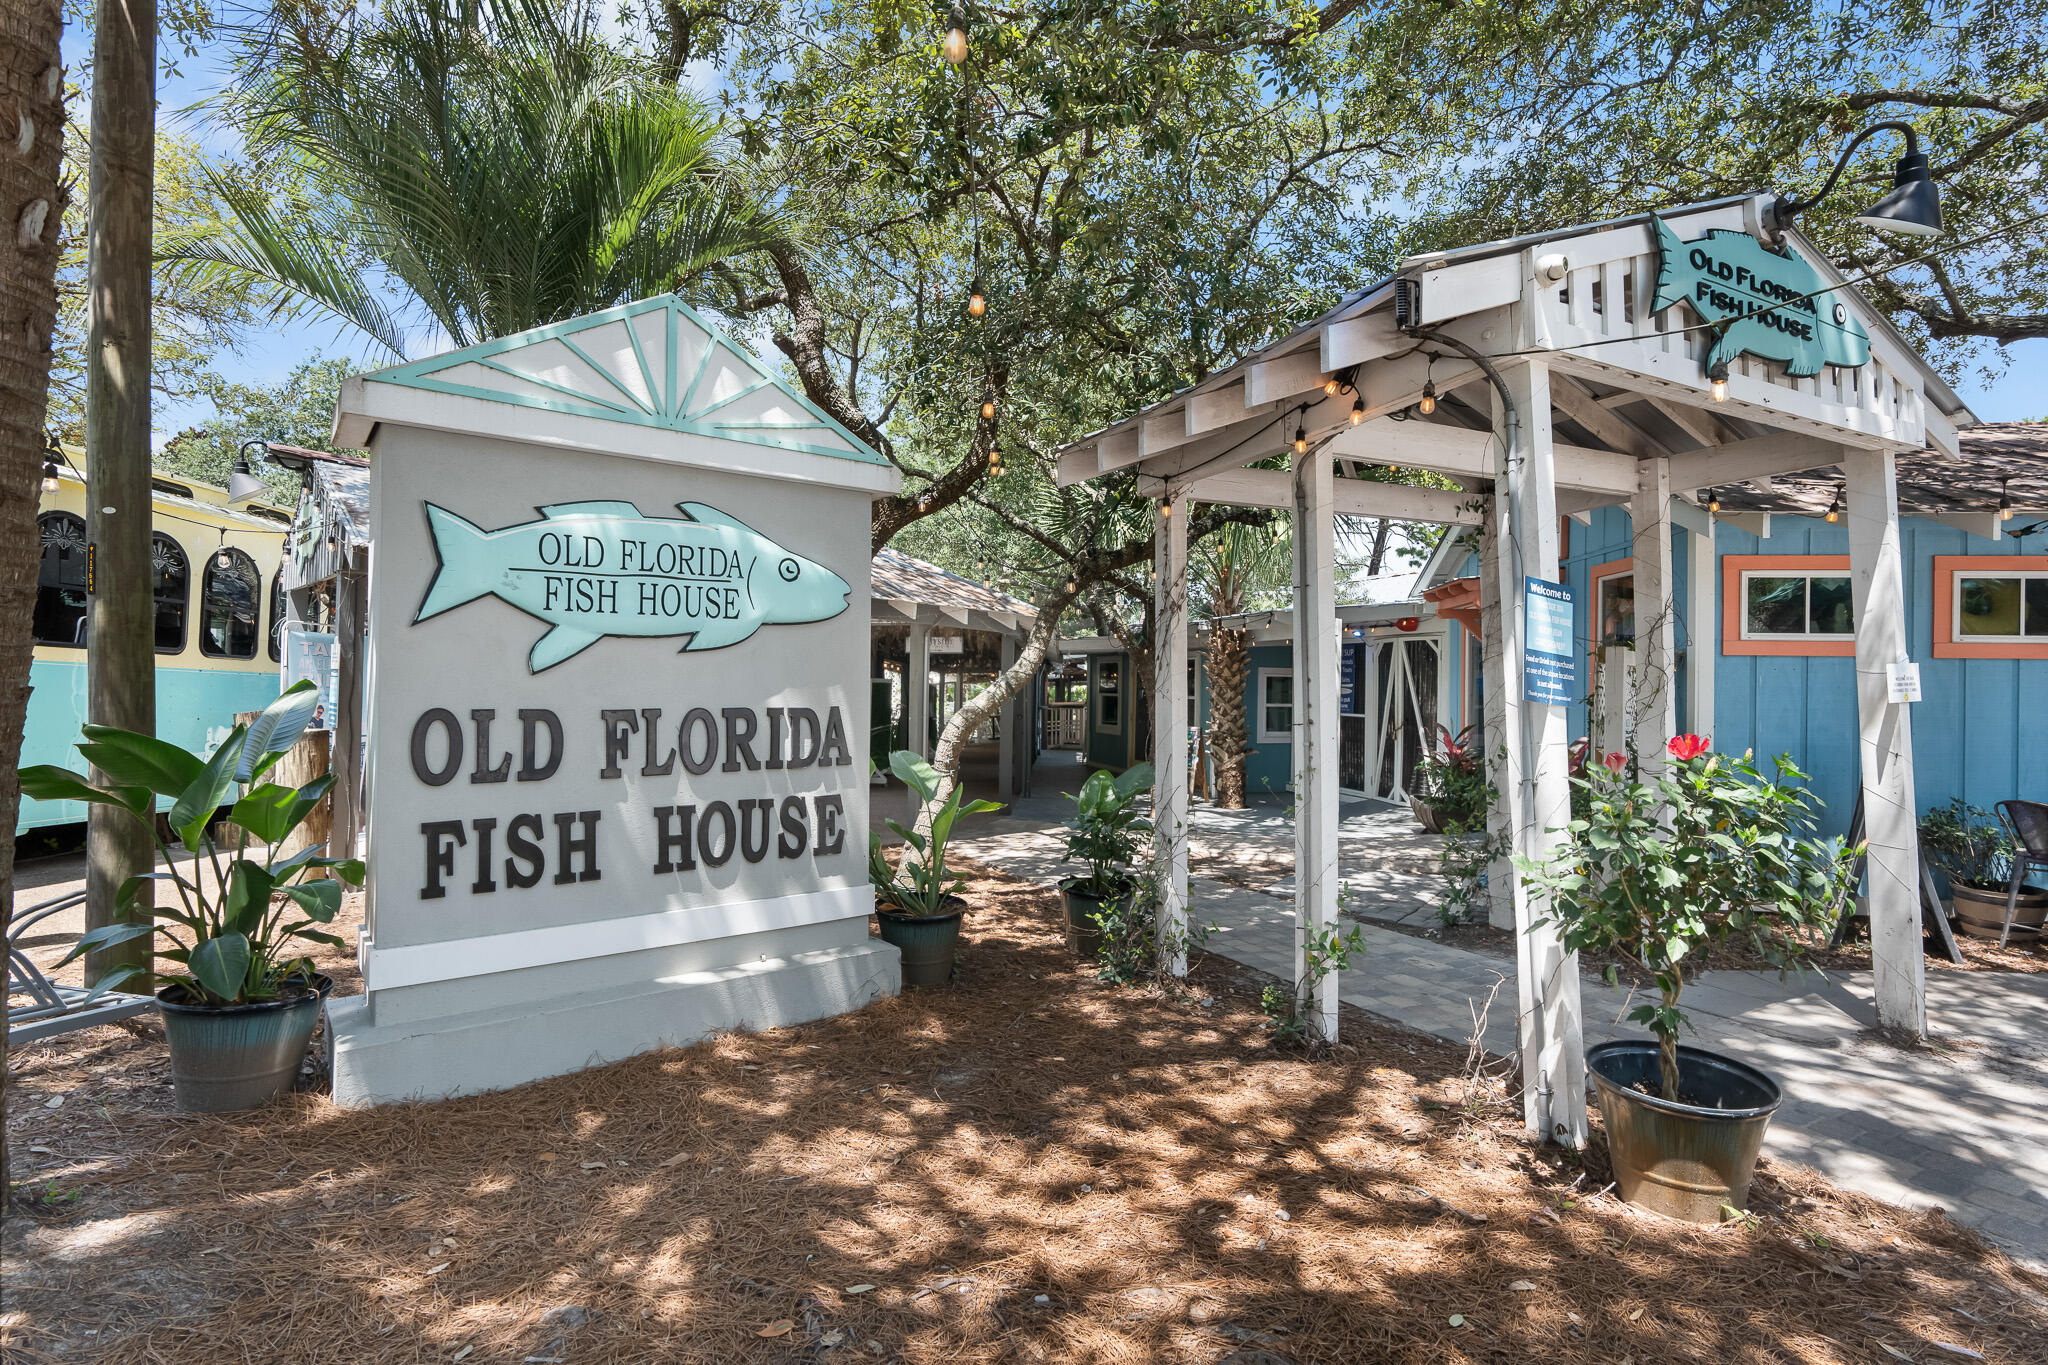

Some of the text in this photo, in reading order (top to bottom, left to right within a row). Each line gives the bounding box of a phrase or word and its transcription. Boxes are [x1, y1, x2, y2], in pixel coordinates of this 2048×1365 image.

[1689, 248, 1817, 315] OLD FLORIDA
[1696, 281, 1814, 342] FISH HOUSE
[538, 532, 744, 578] OLD FLORIDA
[543, 577, 741, 620] FISH HOUSE
[1530, 582, 1571, 601] Welcome to
[410, 705, 853, 787] OLD FLORIDA
[420, 794, 845, 900] FISH HOUSE
